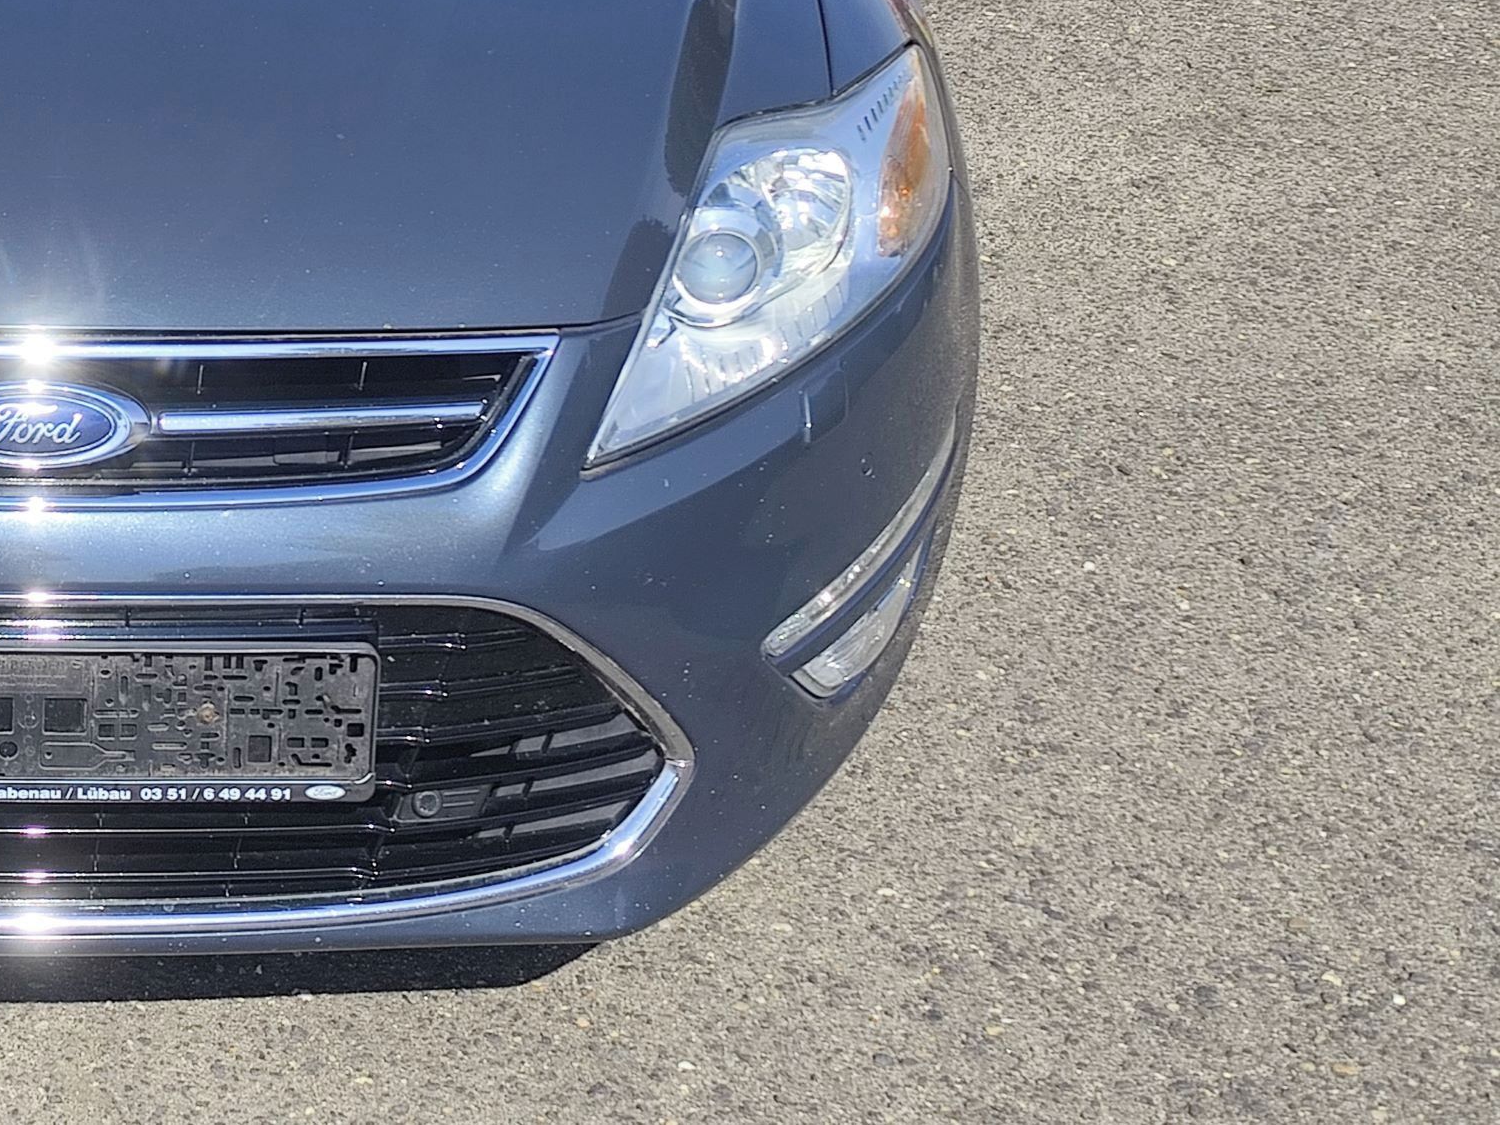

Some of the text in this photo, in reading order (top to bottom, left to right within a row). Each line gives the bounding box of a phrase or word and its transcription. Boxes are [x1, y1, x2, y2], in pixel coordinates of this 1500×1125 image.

[76, 785, 132, 801] Lübau
[140, 787, 163, 801] 03
[166, 787, 188, 801] 51
[203, 787, 215, 802] 6
[216, 787, 241, 802] 49
[245, 787, 268, 802] 44
[270, 787, 291, 802] 91
